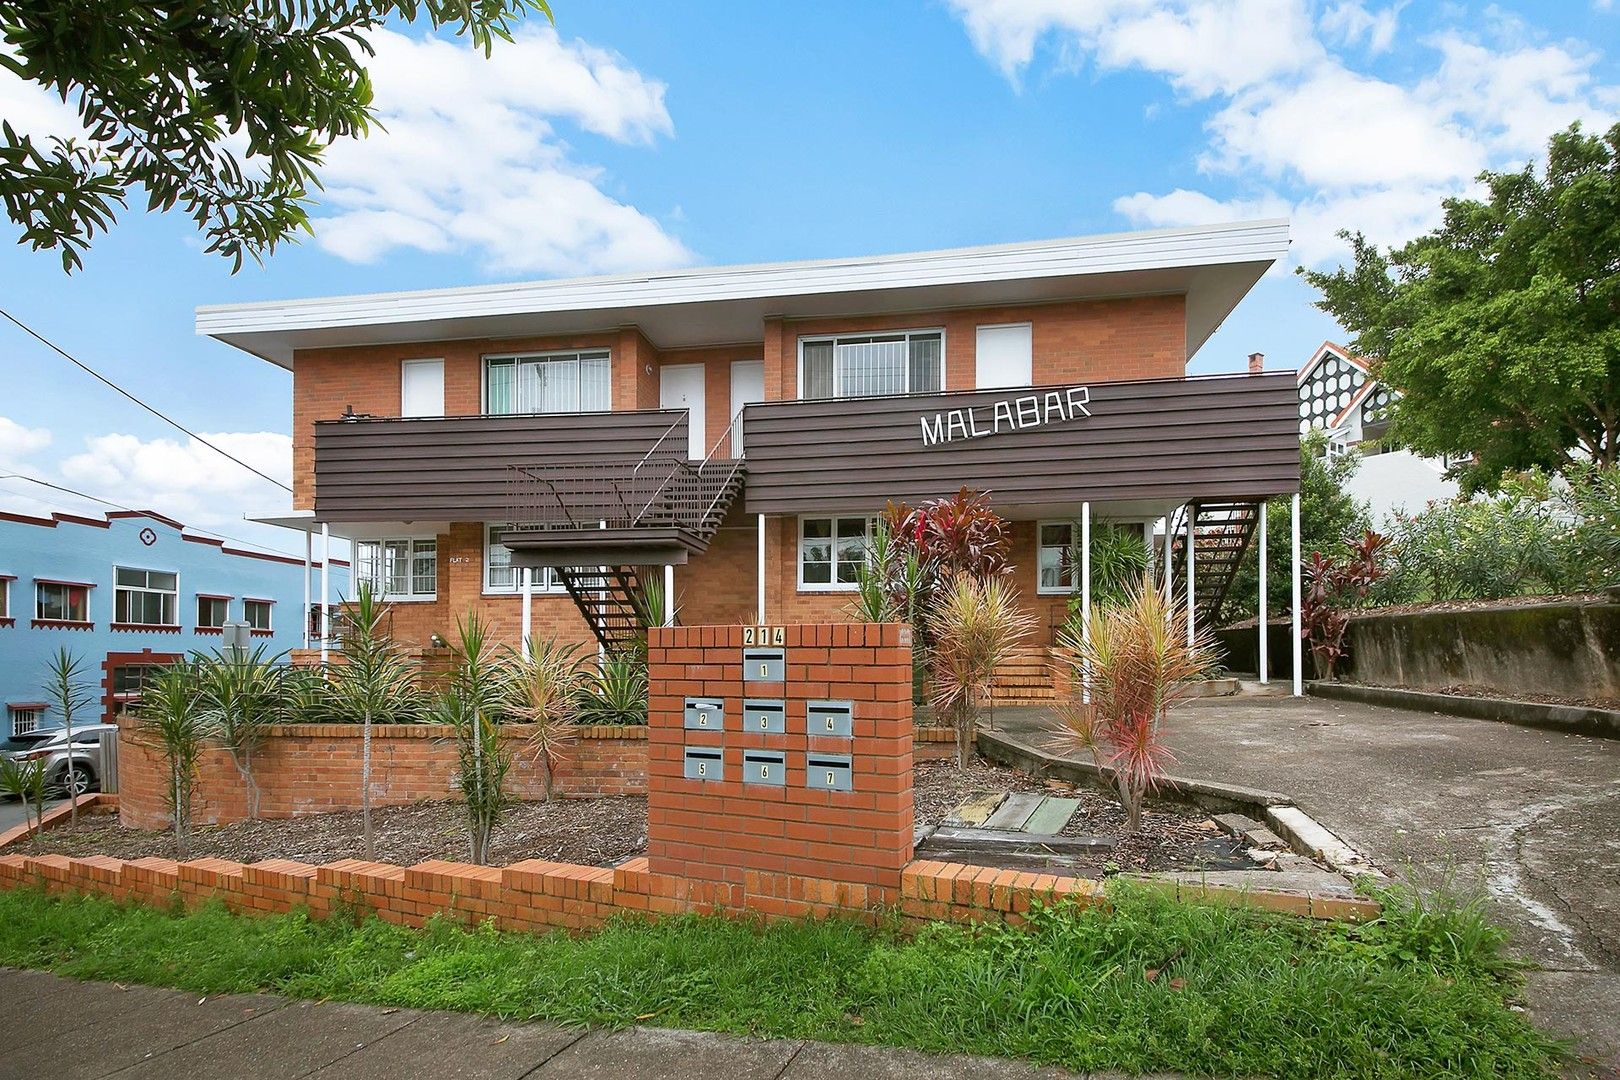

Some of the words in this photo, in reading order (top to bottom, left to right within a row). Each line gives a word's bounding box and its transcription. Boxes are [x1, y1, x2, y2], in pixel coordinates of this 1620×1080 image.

[920, 387, 1091, 446] MALABAR
[762, 665, 767, 676] 1
[700, 714, 707, 725] 2
[761, 717, 768, 728] 3
[827, 718, 834, 730] 4
[699, 764, 706, 775] 5
[762, 766, 768, 778] 6
[827, 773, 834, 784] 7
